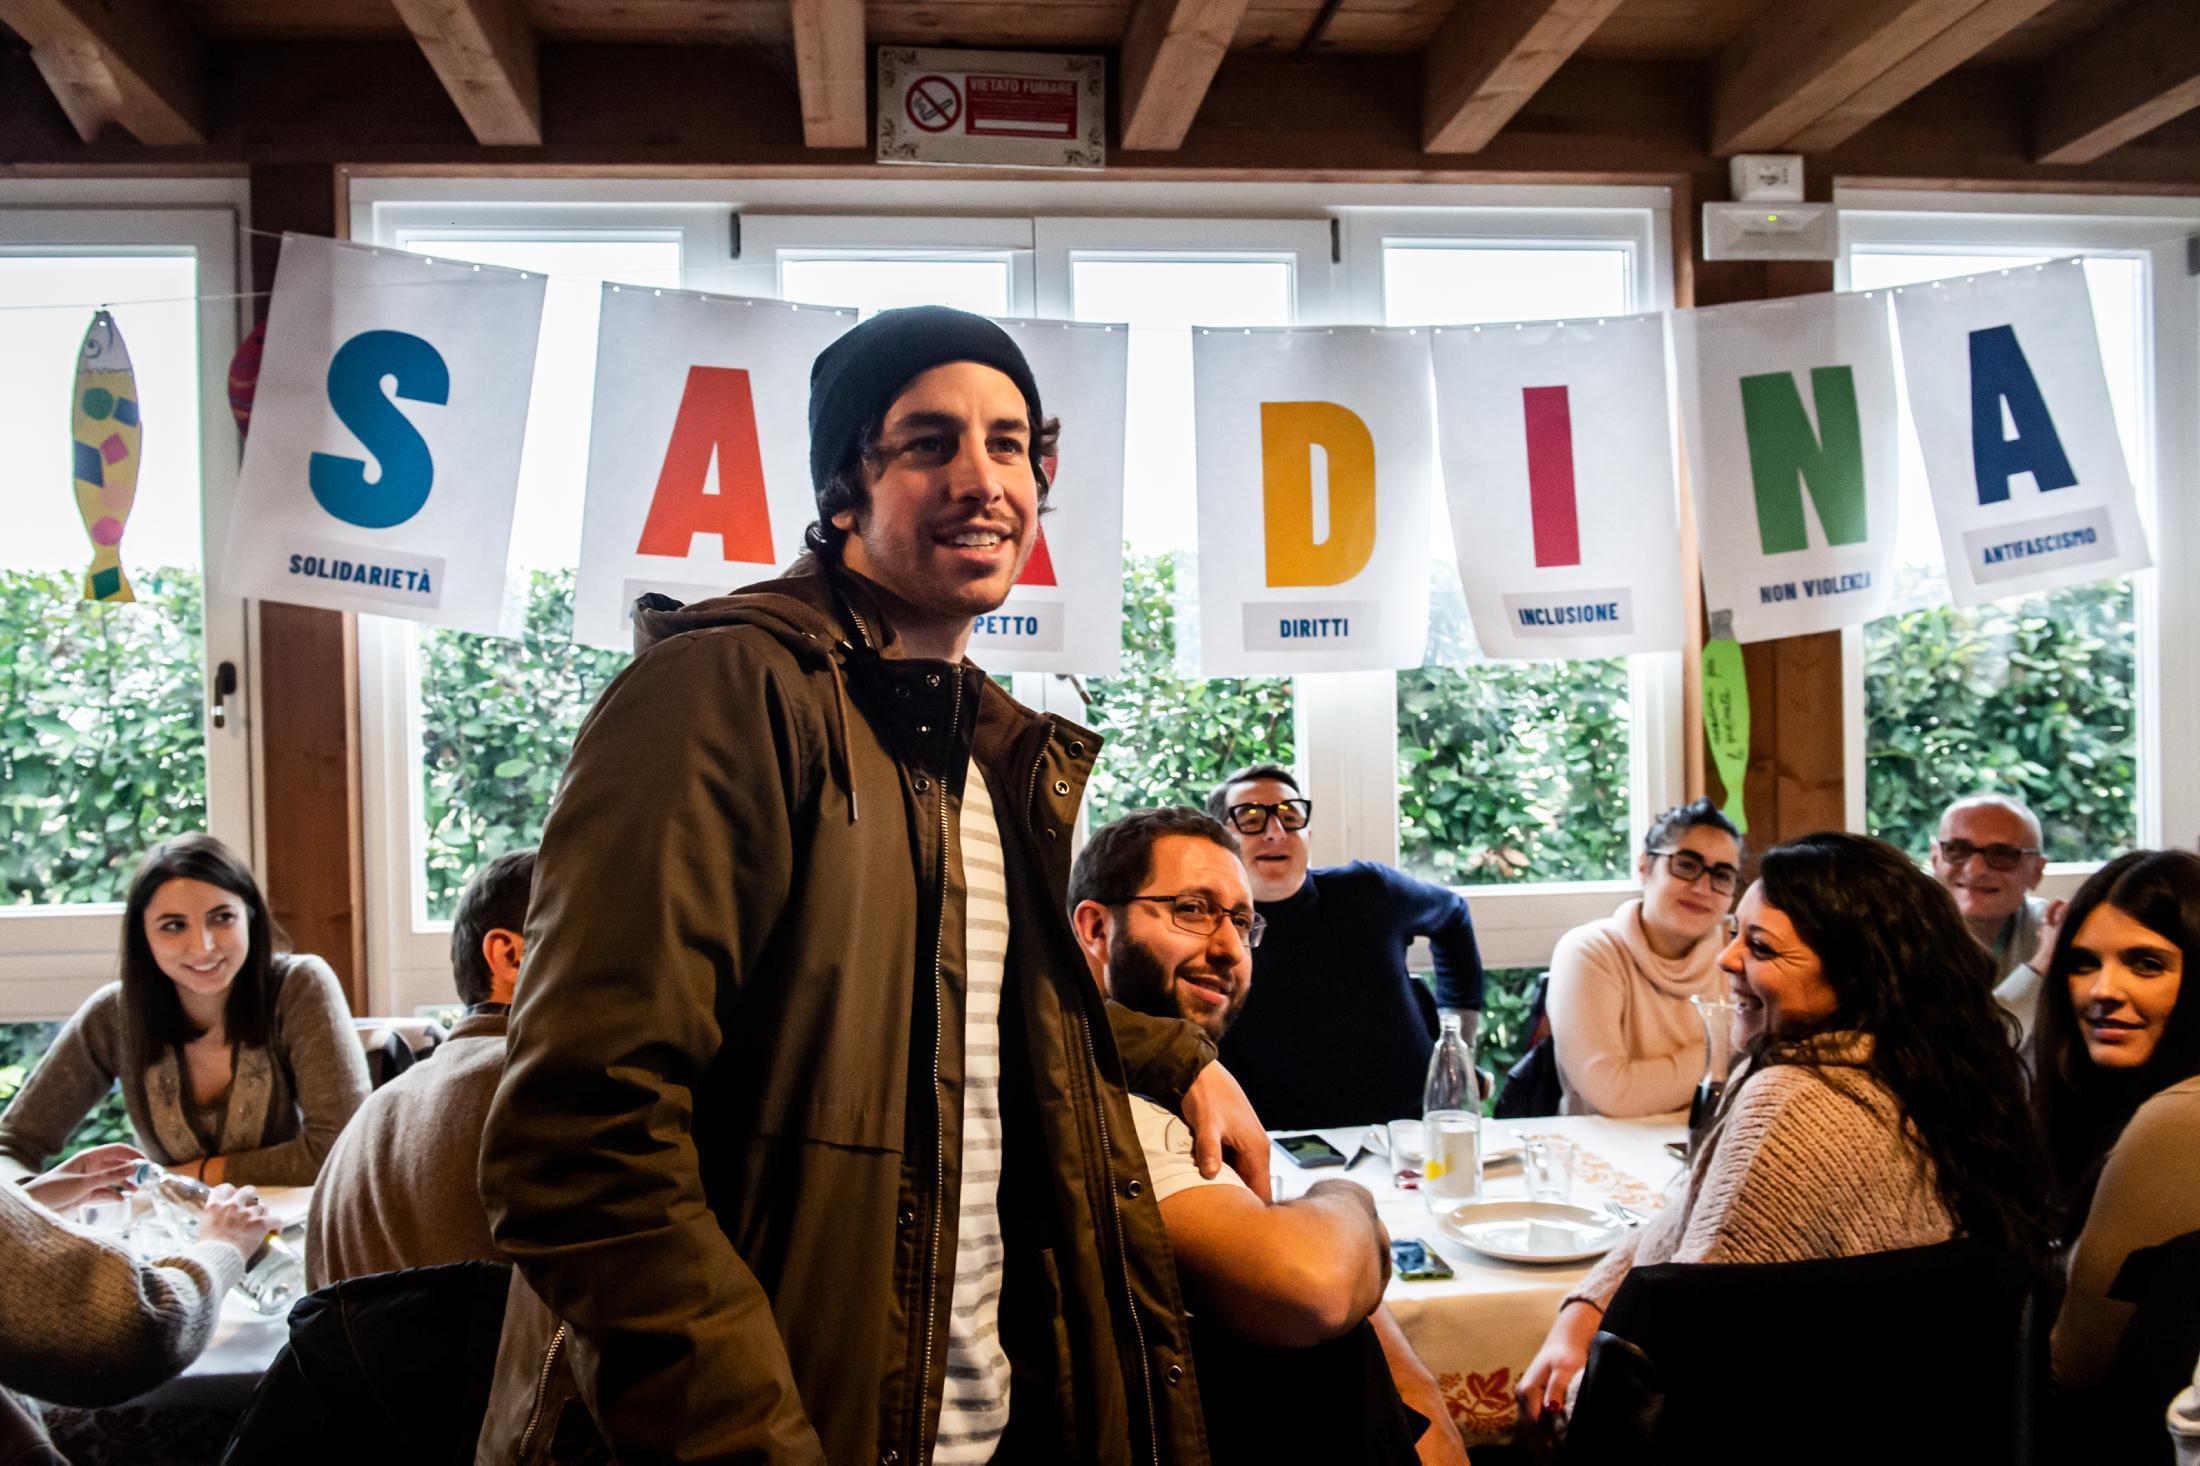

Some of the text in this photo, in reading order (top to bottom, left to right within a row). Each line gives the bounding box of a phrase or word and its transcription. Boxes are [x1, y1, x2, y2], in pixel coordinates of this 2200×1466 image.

[969, 78, 1074, 96] VIETATO FUMARE
[1983, 527, 2097, 564] ANTIFASCISMO
[289, 554, 431, 593] SOLIDARIETÀ
[1760, 571, 1871, 603] NON VIOLENZA
[973, 615, 1039, 636] PETTO
[1518, 603, 1619, 626] INCLUSIONE
[1280, 618, 1348, 638] DIRITTI
